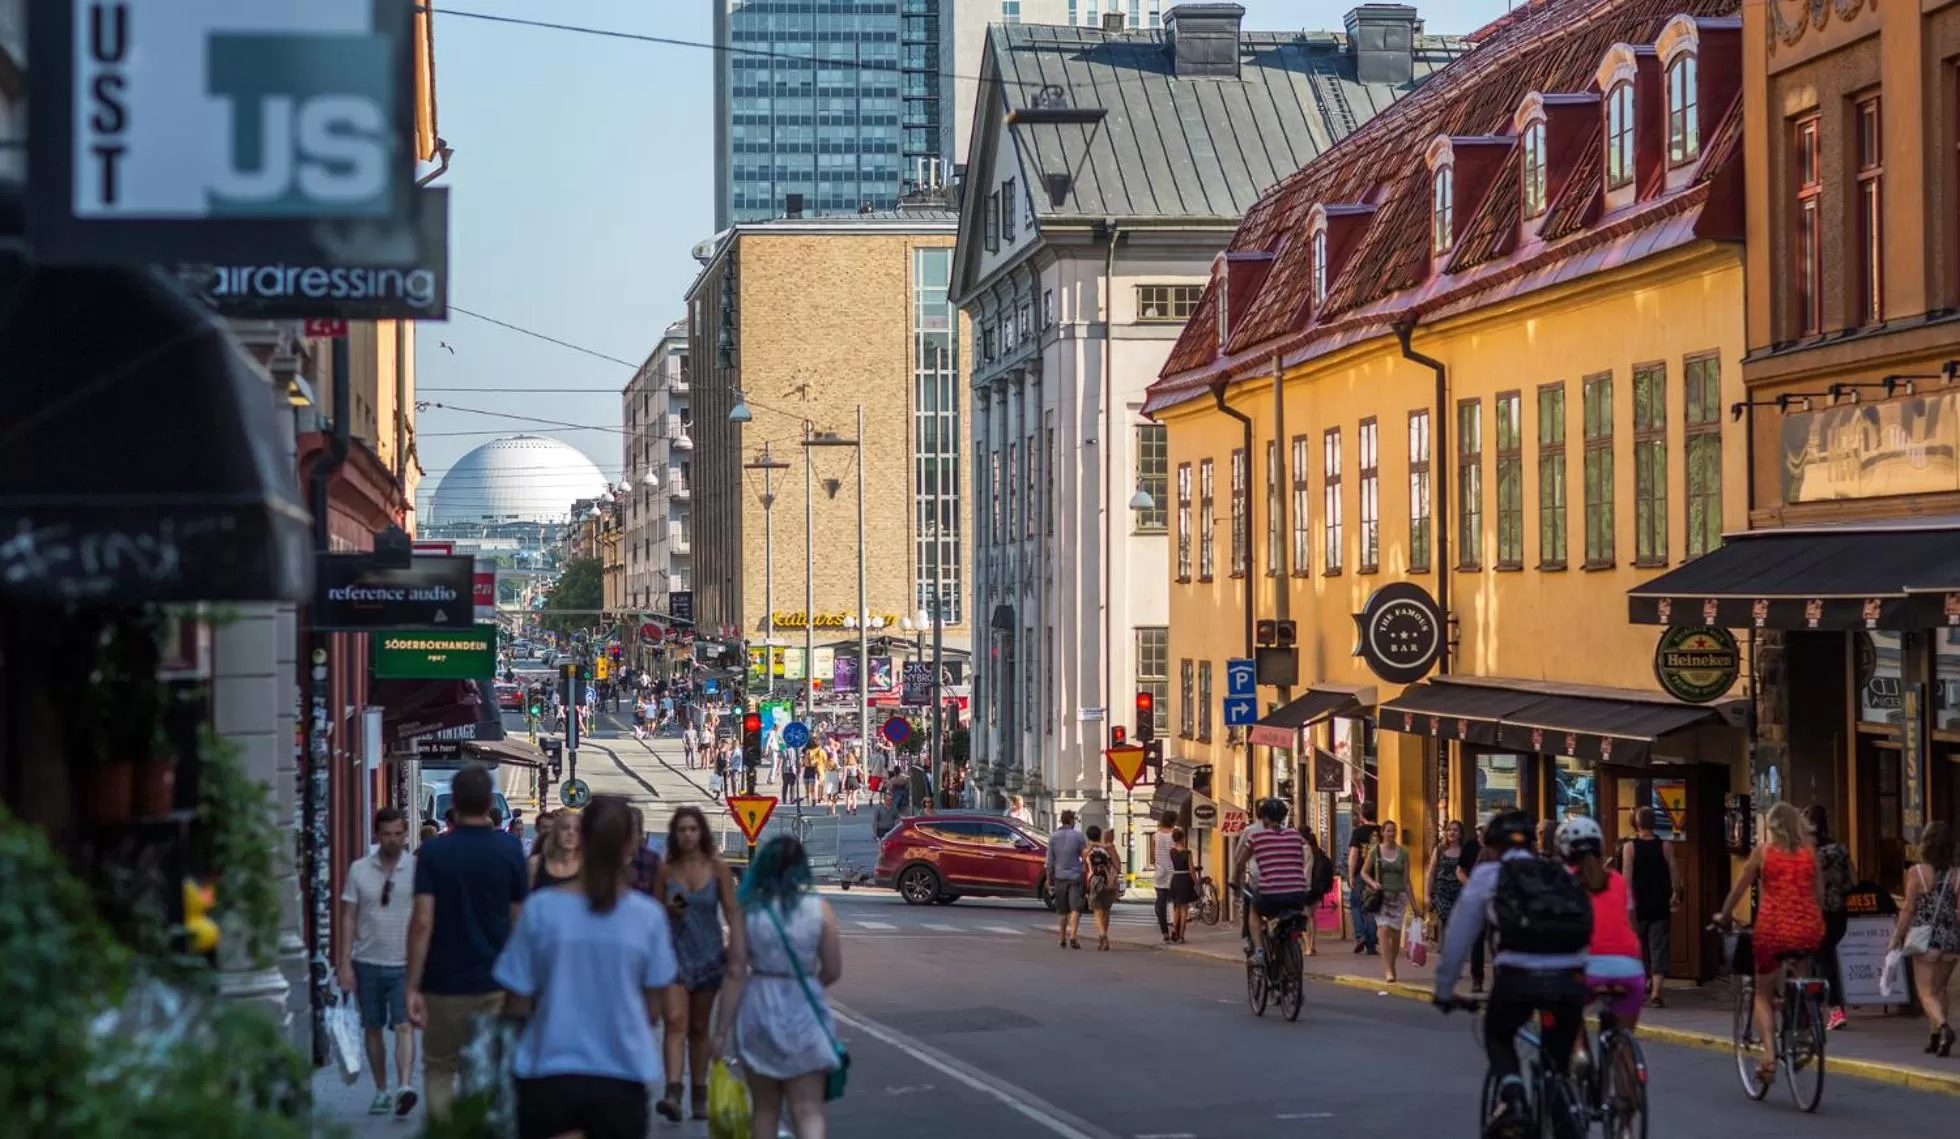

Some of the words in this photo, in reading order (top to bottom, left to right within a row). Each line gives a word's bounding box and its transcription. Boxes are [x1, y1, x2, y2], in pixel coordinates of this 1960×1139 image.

[328, 584, 405, 601] reference
[408, 584, 457, 601] audio
[1379, 613, 1395, 632] THE
[1394, 608, 1429, 632] FAMOUS
[384, 637, 488, 651] SÖDERBOKHANDELN
[1390, 644, 1419, 652] BAR
[1667, 653, 1733, 667] Heineken
[1236, 671, 1249, 691] P
[437, 723, 476, 740] VINTAGE
